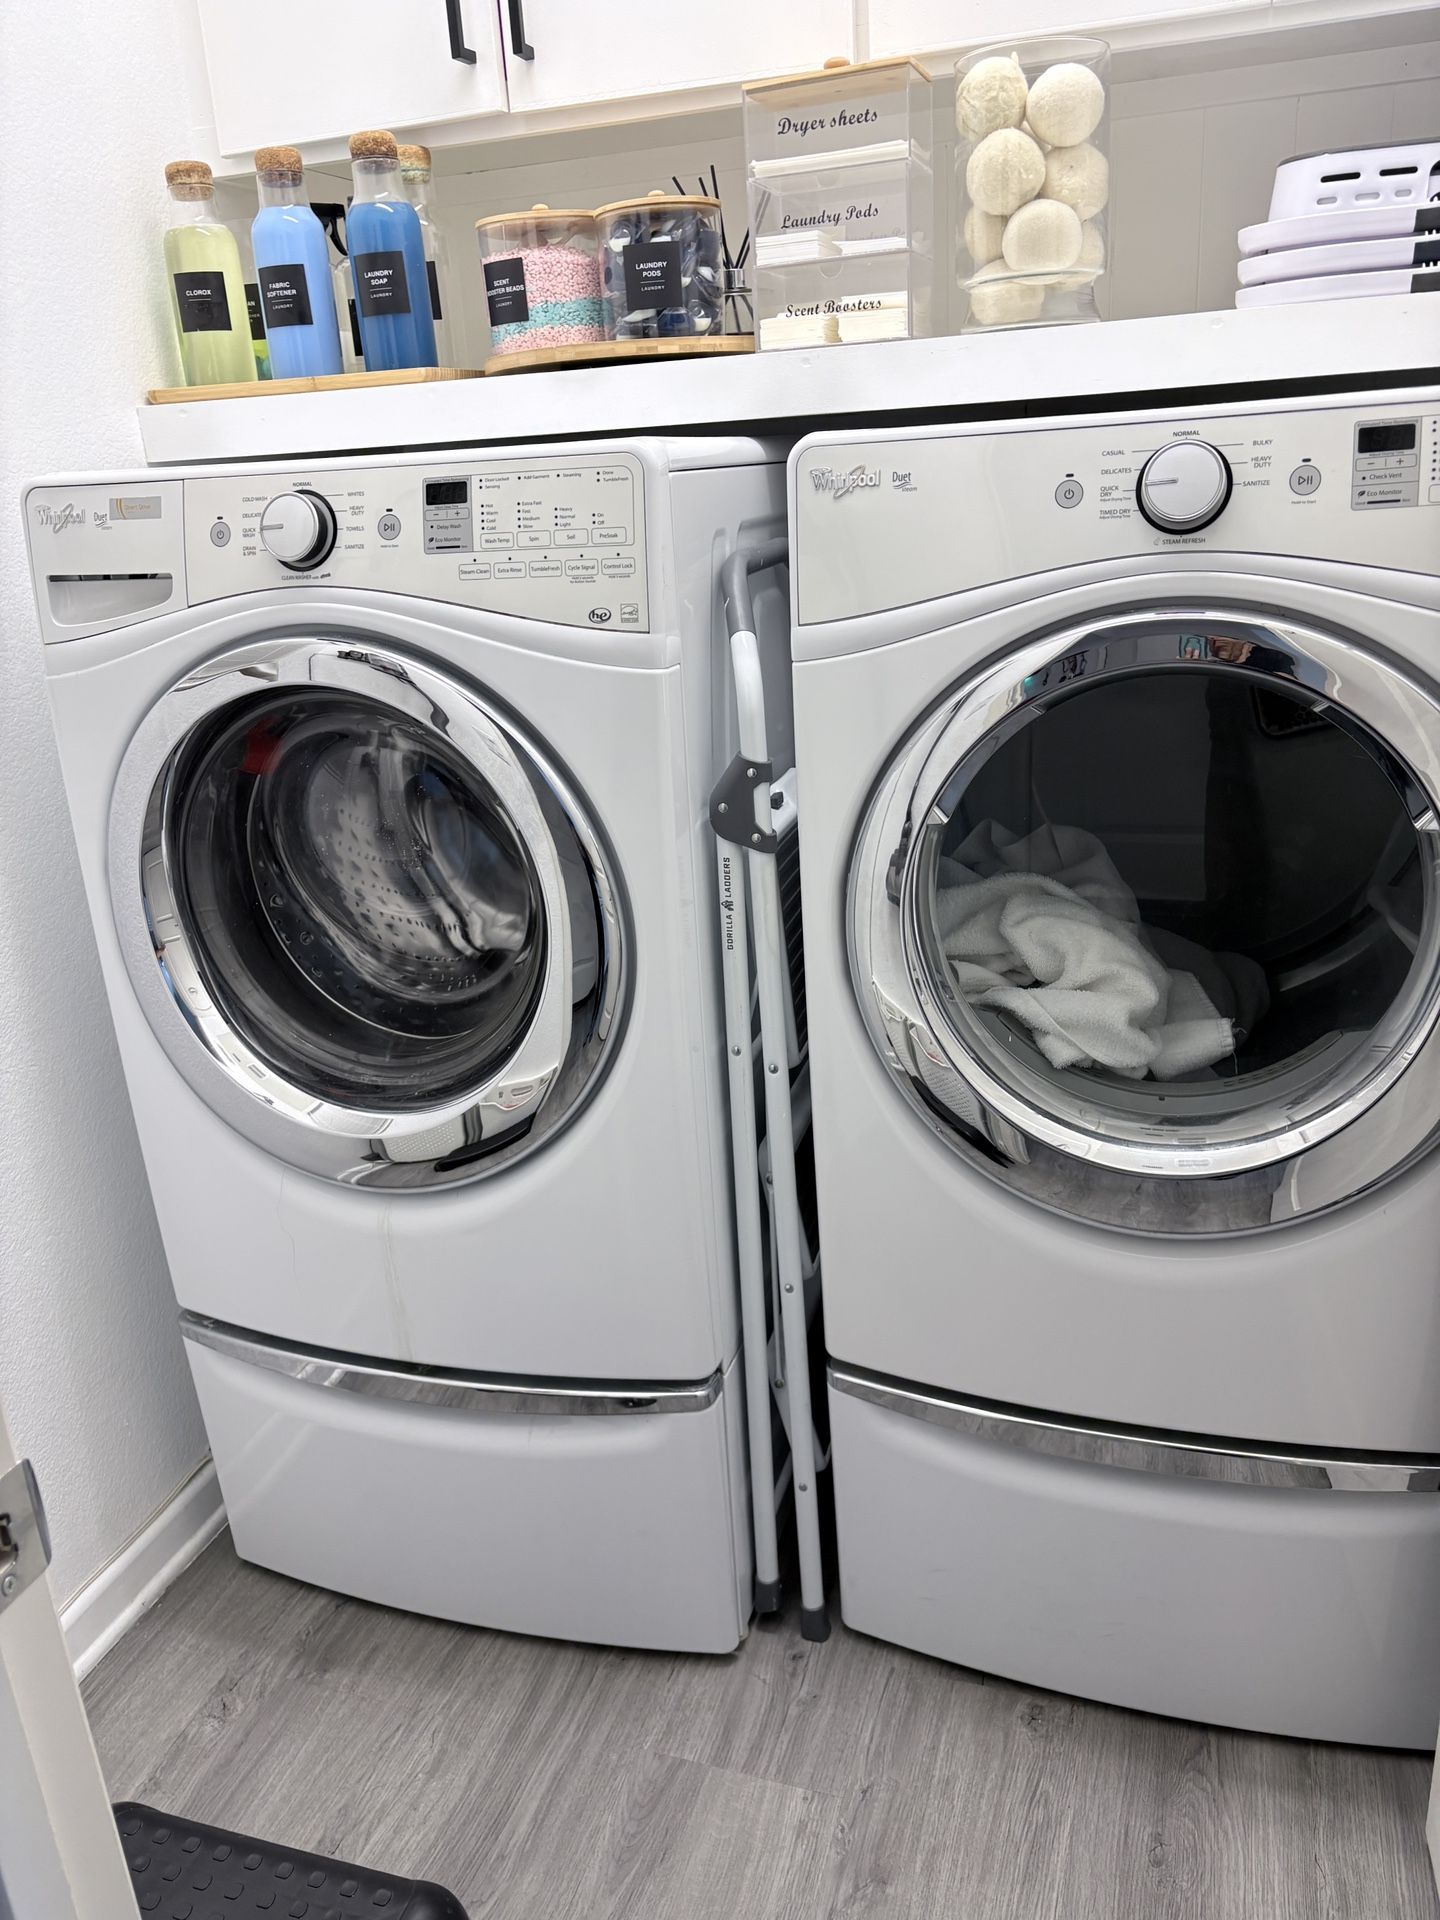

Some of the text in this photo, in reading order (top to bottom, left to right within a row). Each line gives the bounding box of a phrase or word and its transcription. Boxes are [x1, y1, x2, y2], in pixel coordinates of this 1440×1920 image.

[777, 108, 878, 137] Dryer sheets
[780, 203, 879, 230] Laundry Pods
[635, 261, 667, 270] LAUNDRY
[364, 269, 393, 279] LAUNDRY
[642, 270, 662, 278] PODS
[269, 281, 290, 289] FABRIC
[370, 277, 388, 286] SOAP
[493, 278, 510, 287] SCENT
[266, 289, 297, 298] SOFTENER
[505, 284, 525, 293] BEADS
[785, 298, 882, 319] Scent Boosters
[810, 465, 881, 499] Whirlpool
[892, 471, 912, 483] Duet
[1242, 479, 1270, 487] SANITIZE
[34, 503, 86, 534] Whirlpool
[93, 511, 108, 522] Duet
[723, 857, 734, 950] GORILLA LADDERS
